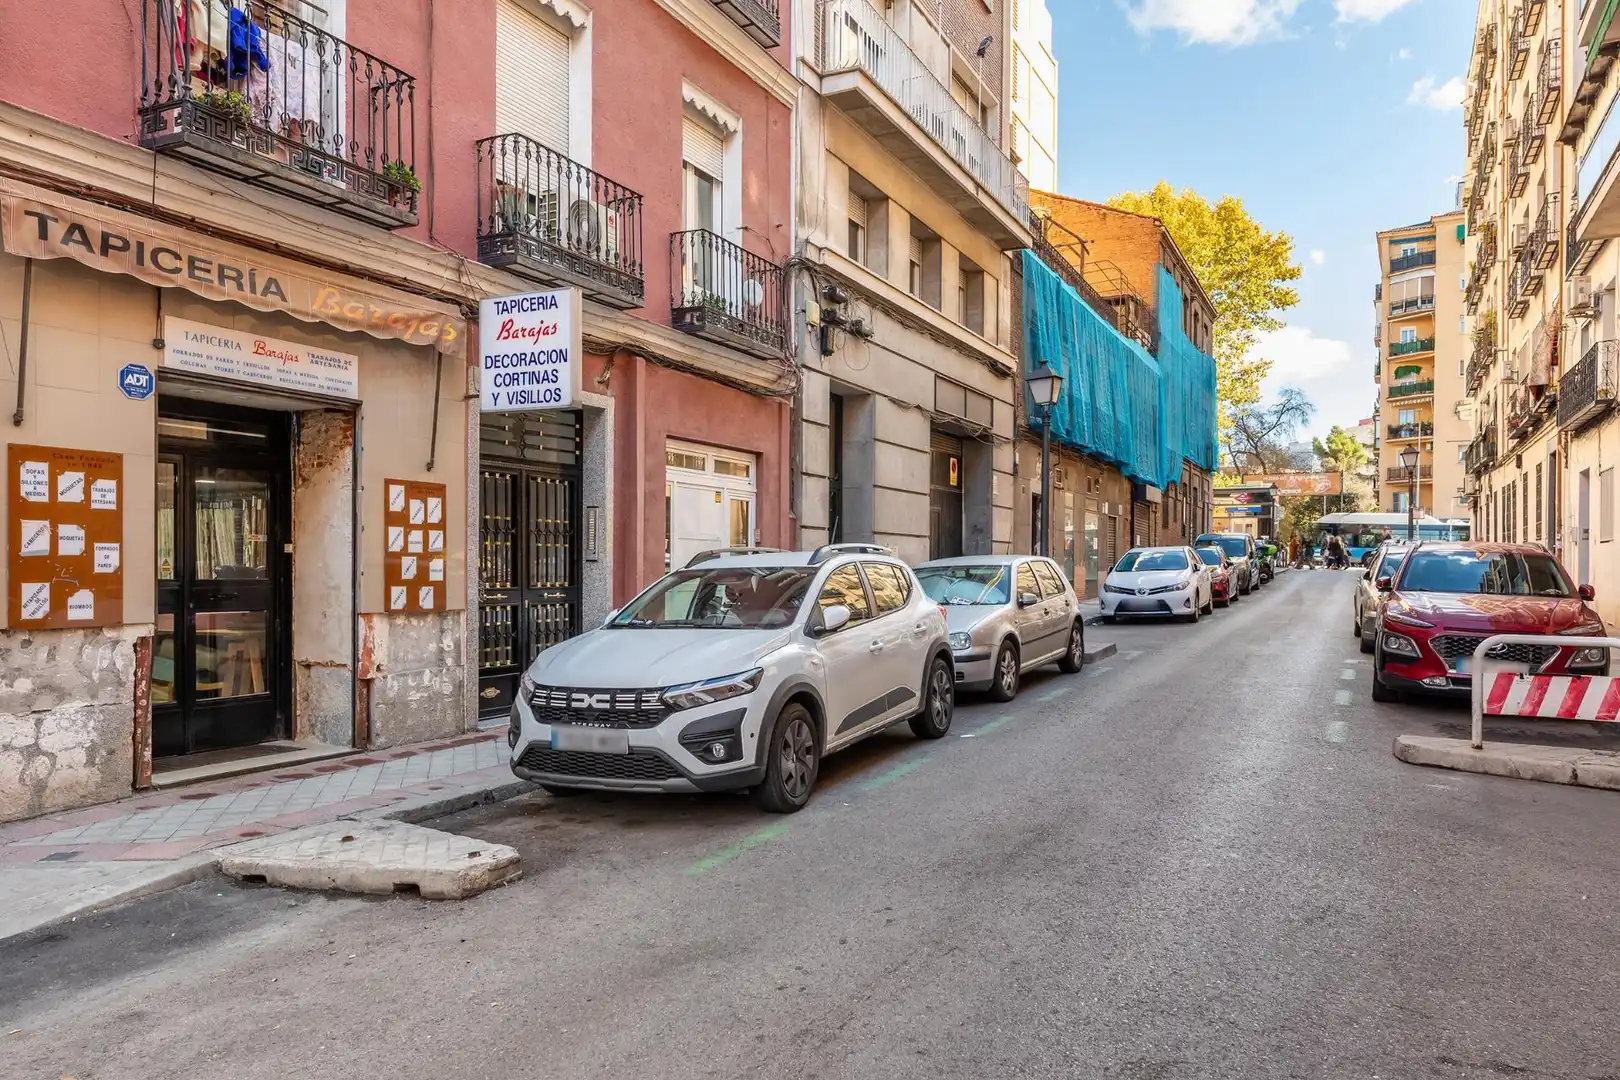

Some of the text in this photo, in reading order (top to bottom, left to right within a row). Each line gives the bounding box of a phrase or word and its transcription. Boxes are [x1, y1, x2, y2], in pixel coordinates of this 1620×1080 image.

[24, 210, 457, 342] TAPICERÍA Barajas
[494, 295, 558, 315] TAPICERIA
[496, 318, 558, 346] Barajas
[184, 331, 299, 366] TAPICERIA Barajas
[485, 348, 568, 369] DECORACION
[125, 373, 148, 387] ADT
[494, 369, 559, 388] CORTINAS
[492, 388, 562, 406] Y VISILLOS
[59, 477, 84, 497] MOQUETAS
